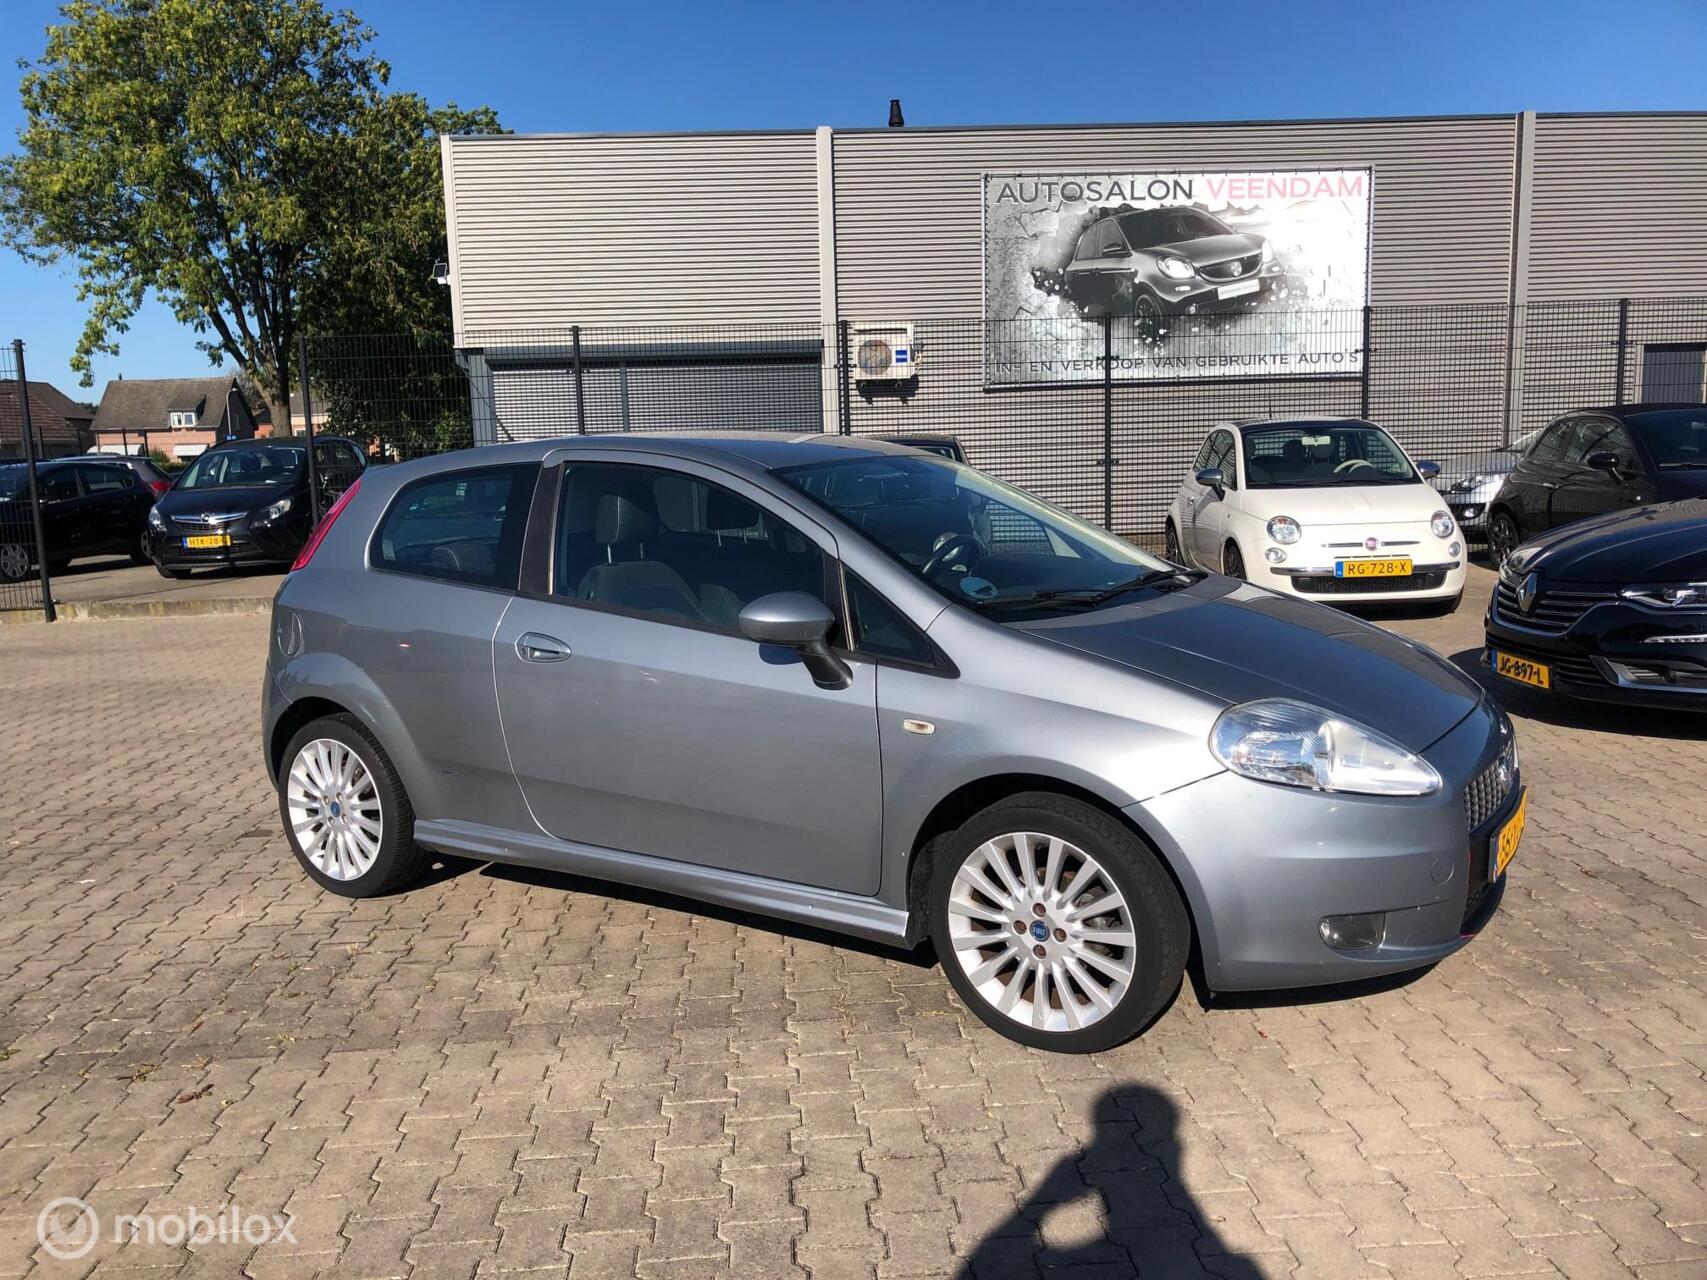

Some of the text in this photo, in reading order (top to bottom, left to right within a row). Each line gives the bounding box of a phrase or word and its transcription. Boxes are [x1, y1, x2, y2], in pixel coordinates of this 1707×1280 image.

[996, 176, 1363, 203] AUTOSALON VEENDAM
[1030, 361, 1052, 373] EN
[1061, 358, 1144, 372] VERKOOP
[1152, 356, 1187, 369] VAN
[1195, 354, 1290, 368] GEBRUIKTE
[1298, 348, 1359, 364] AUTO'S
[1348, 561, 1407, 575] RG-728-X
